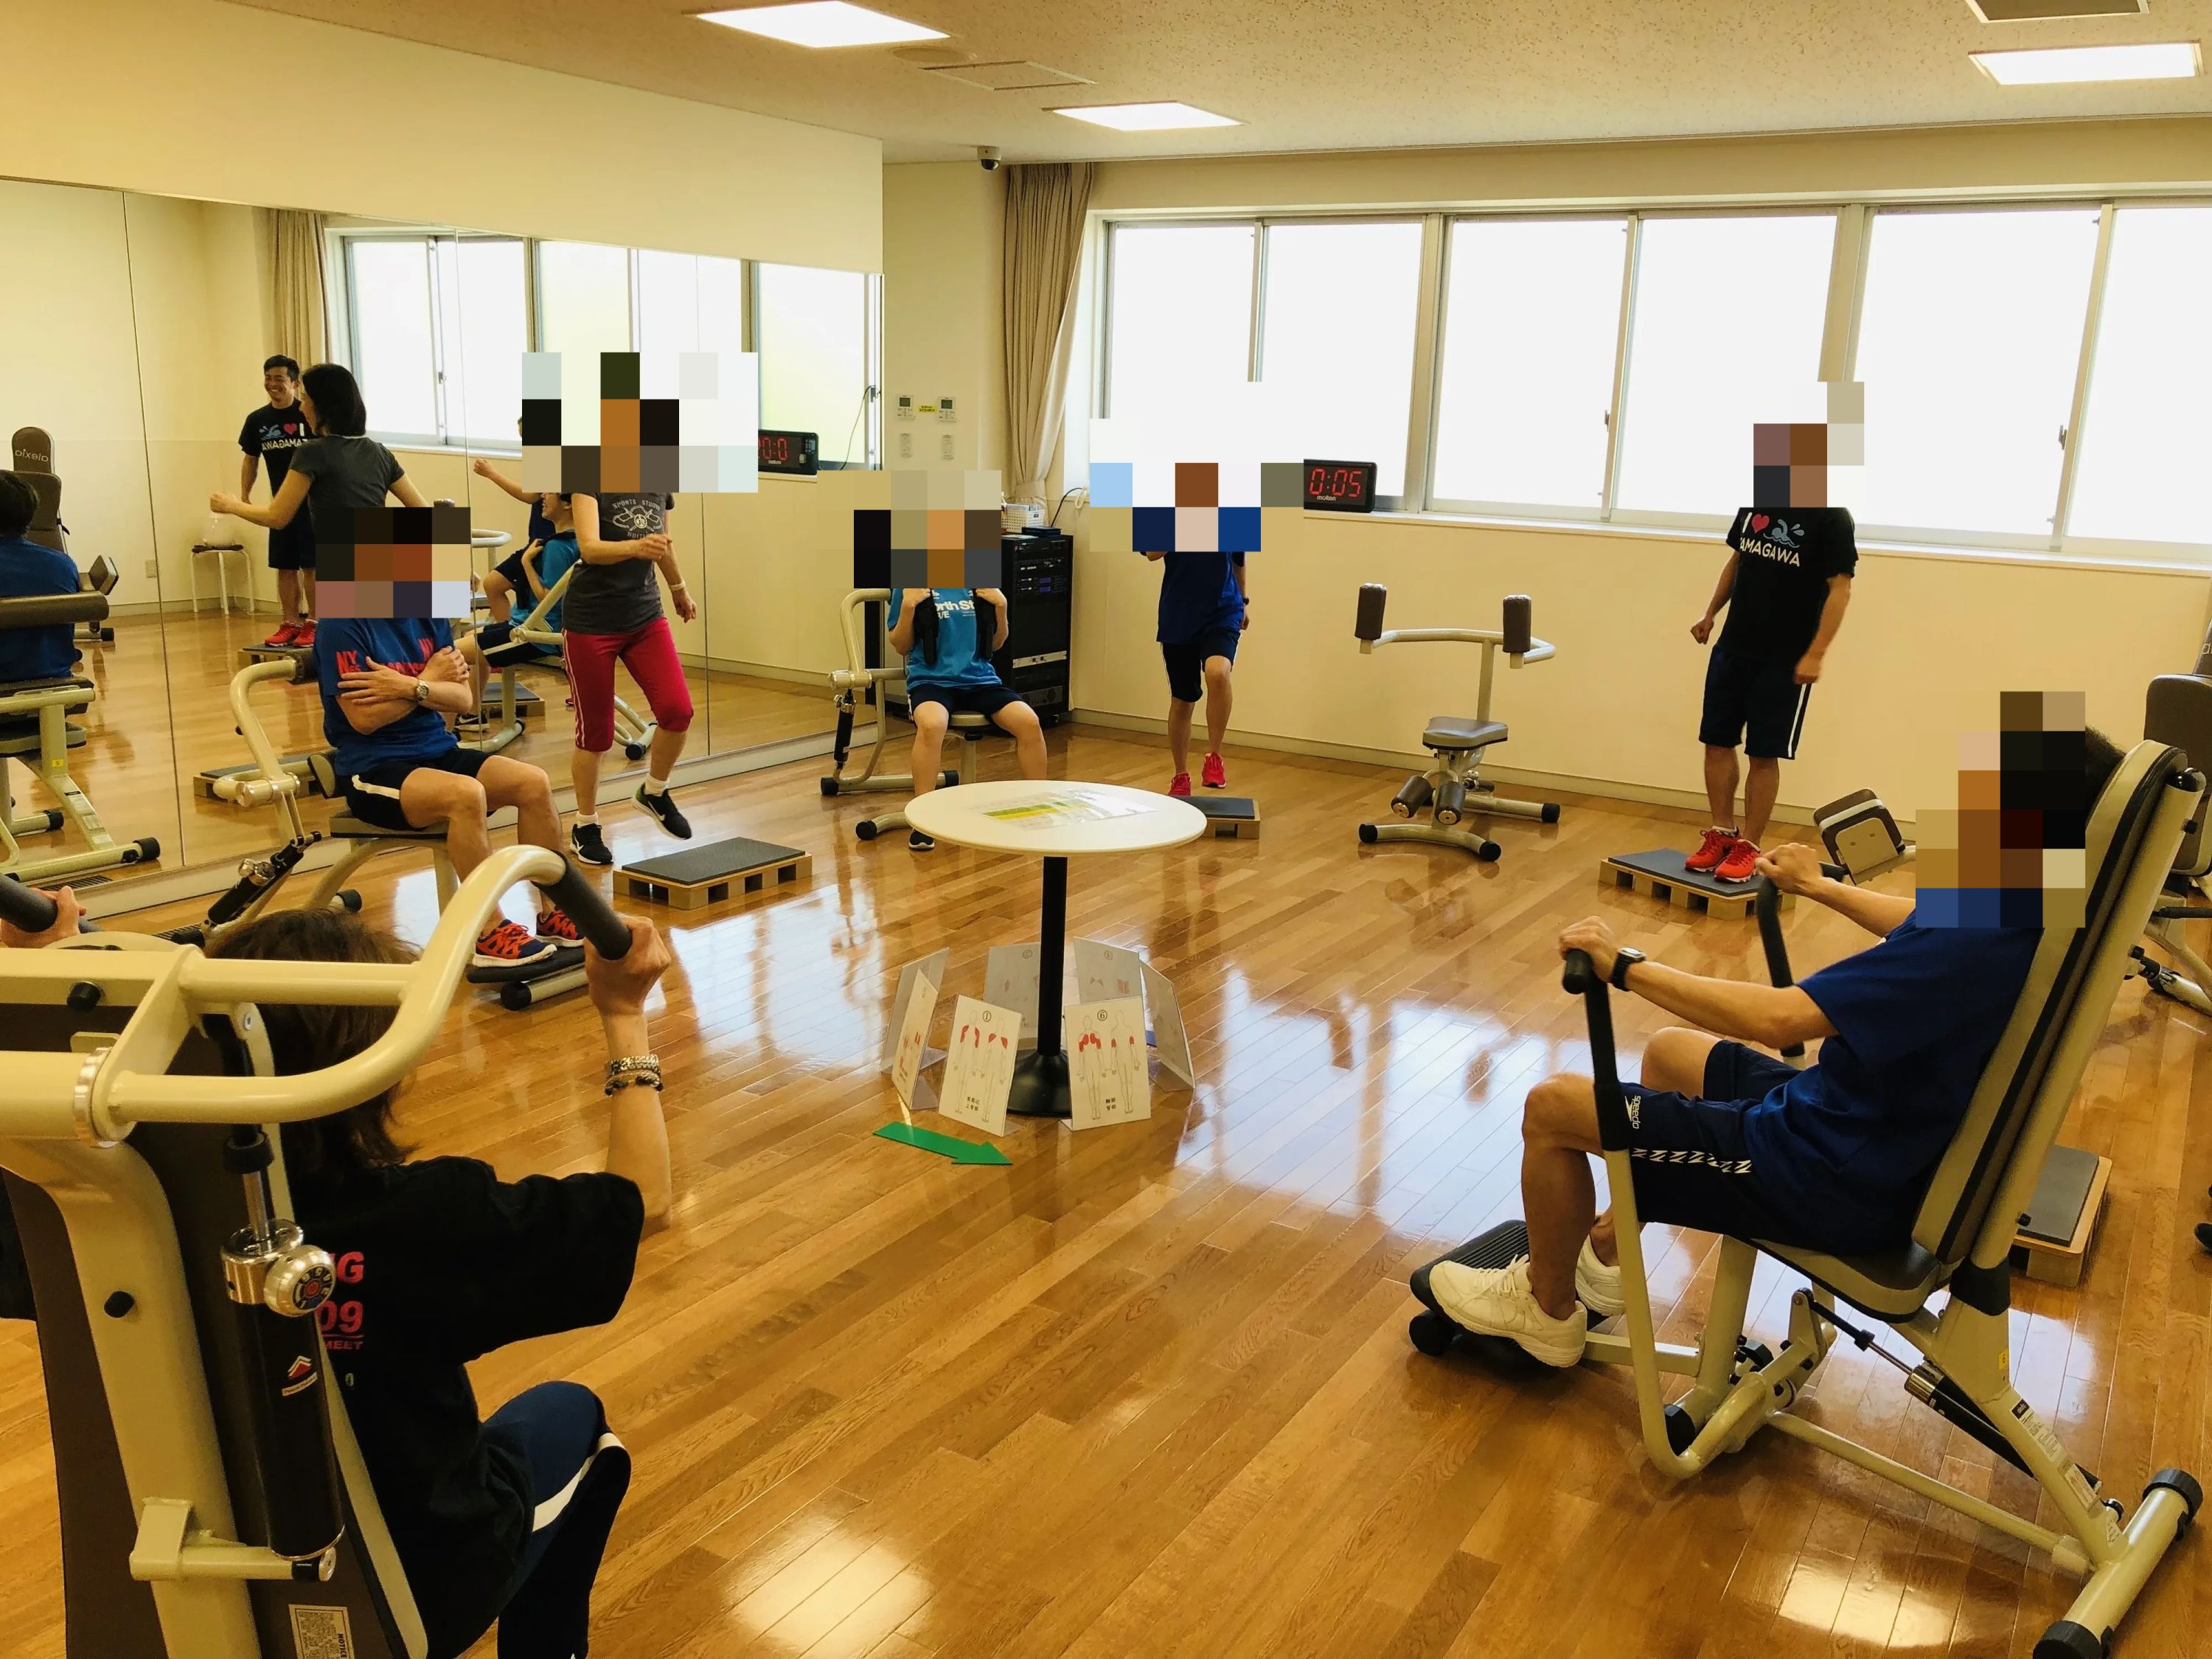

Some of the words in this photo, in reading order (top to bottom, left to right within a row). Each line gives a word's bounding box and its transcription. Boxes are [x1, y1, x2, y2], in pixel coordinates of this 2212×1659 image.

[1309, 468, 1362, 498] 0:05
[612, 498, 636, 509] SPORTS
[1742, 512, 1753, 534] I
[1740, 538, 1800, 567] AMAGAWA
[1632, 1095, 1641, 1130] speedo
[328, 1251, 365, 1284] G
